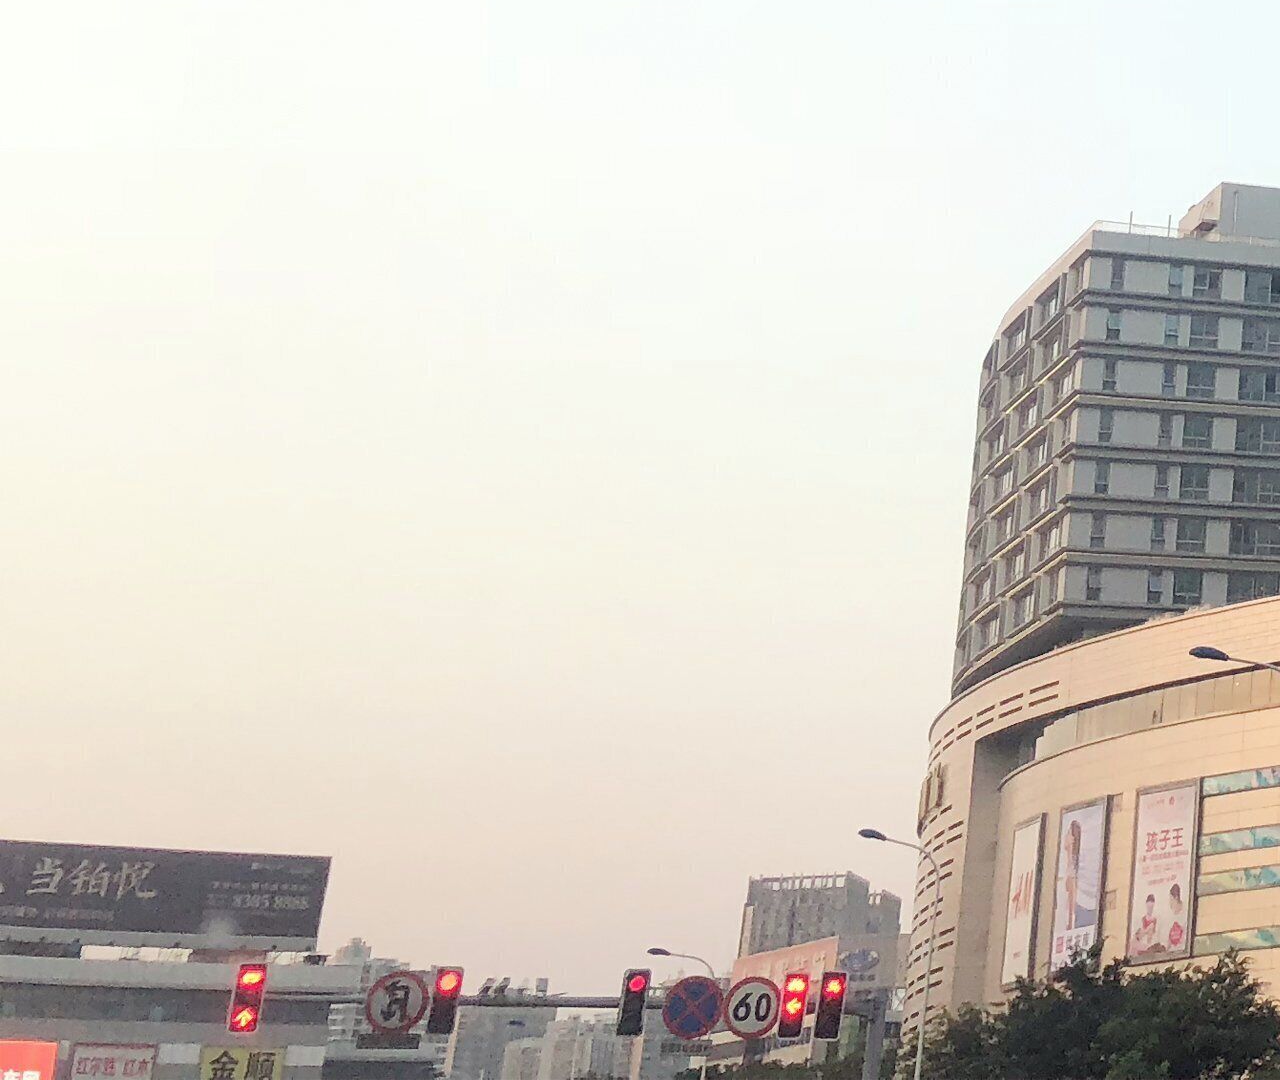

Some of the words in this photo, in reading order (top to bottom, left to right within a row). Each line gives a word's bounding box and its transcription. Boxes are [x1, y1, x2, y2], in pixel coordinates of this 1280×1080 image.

[1146, 827, 1184, 853] 孩子王
[732, 993, 771, 1022] 60
